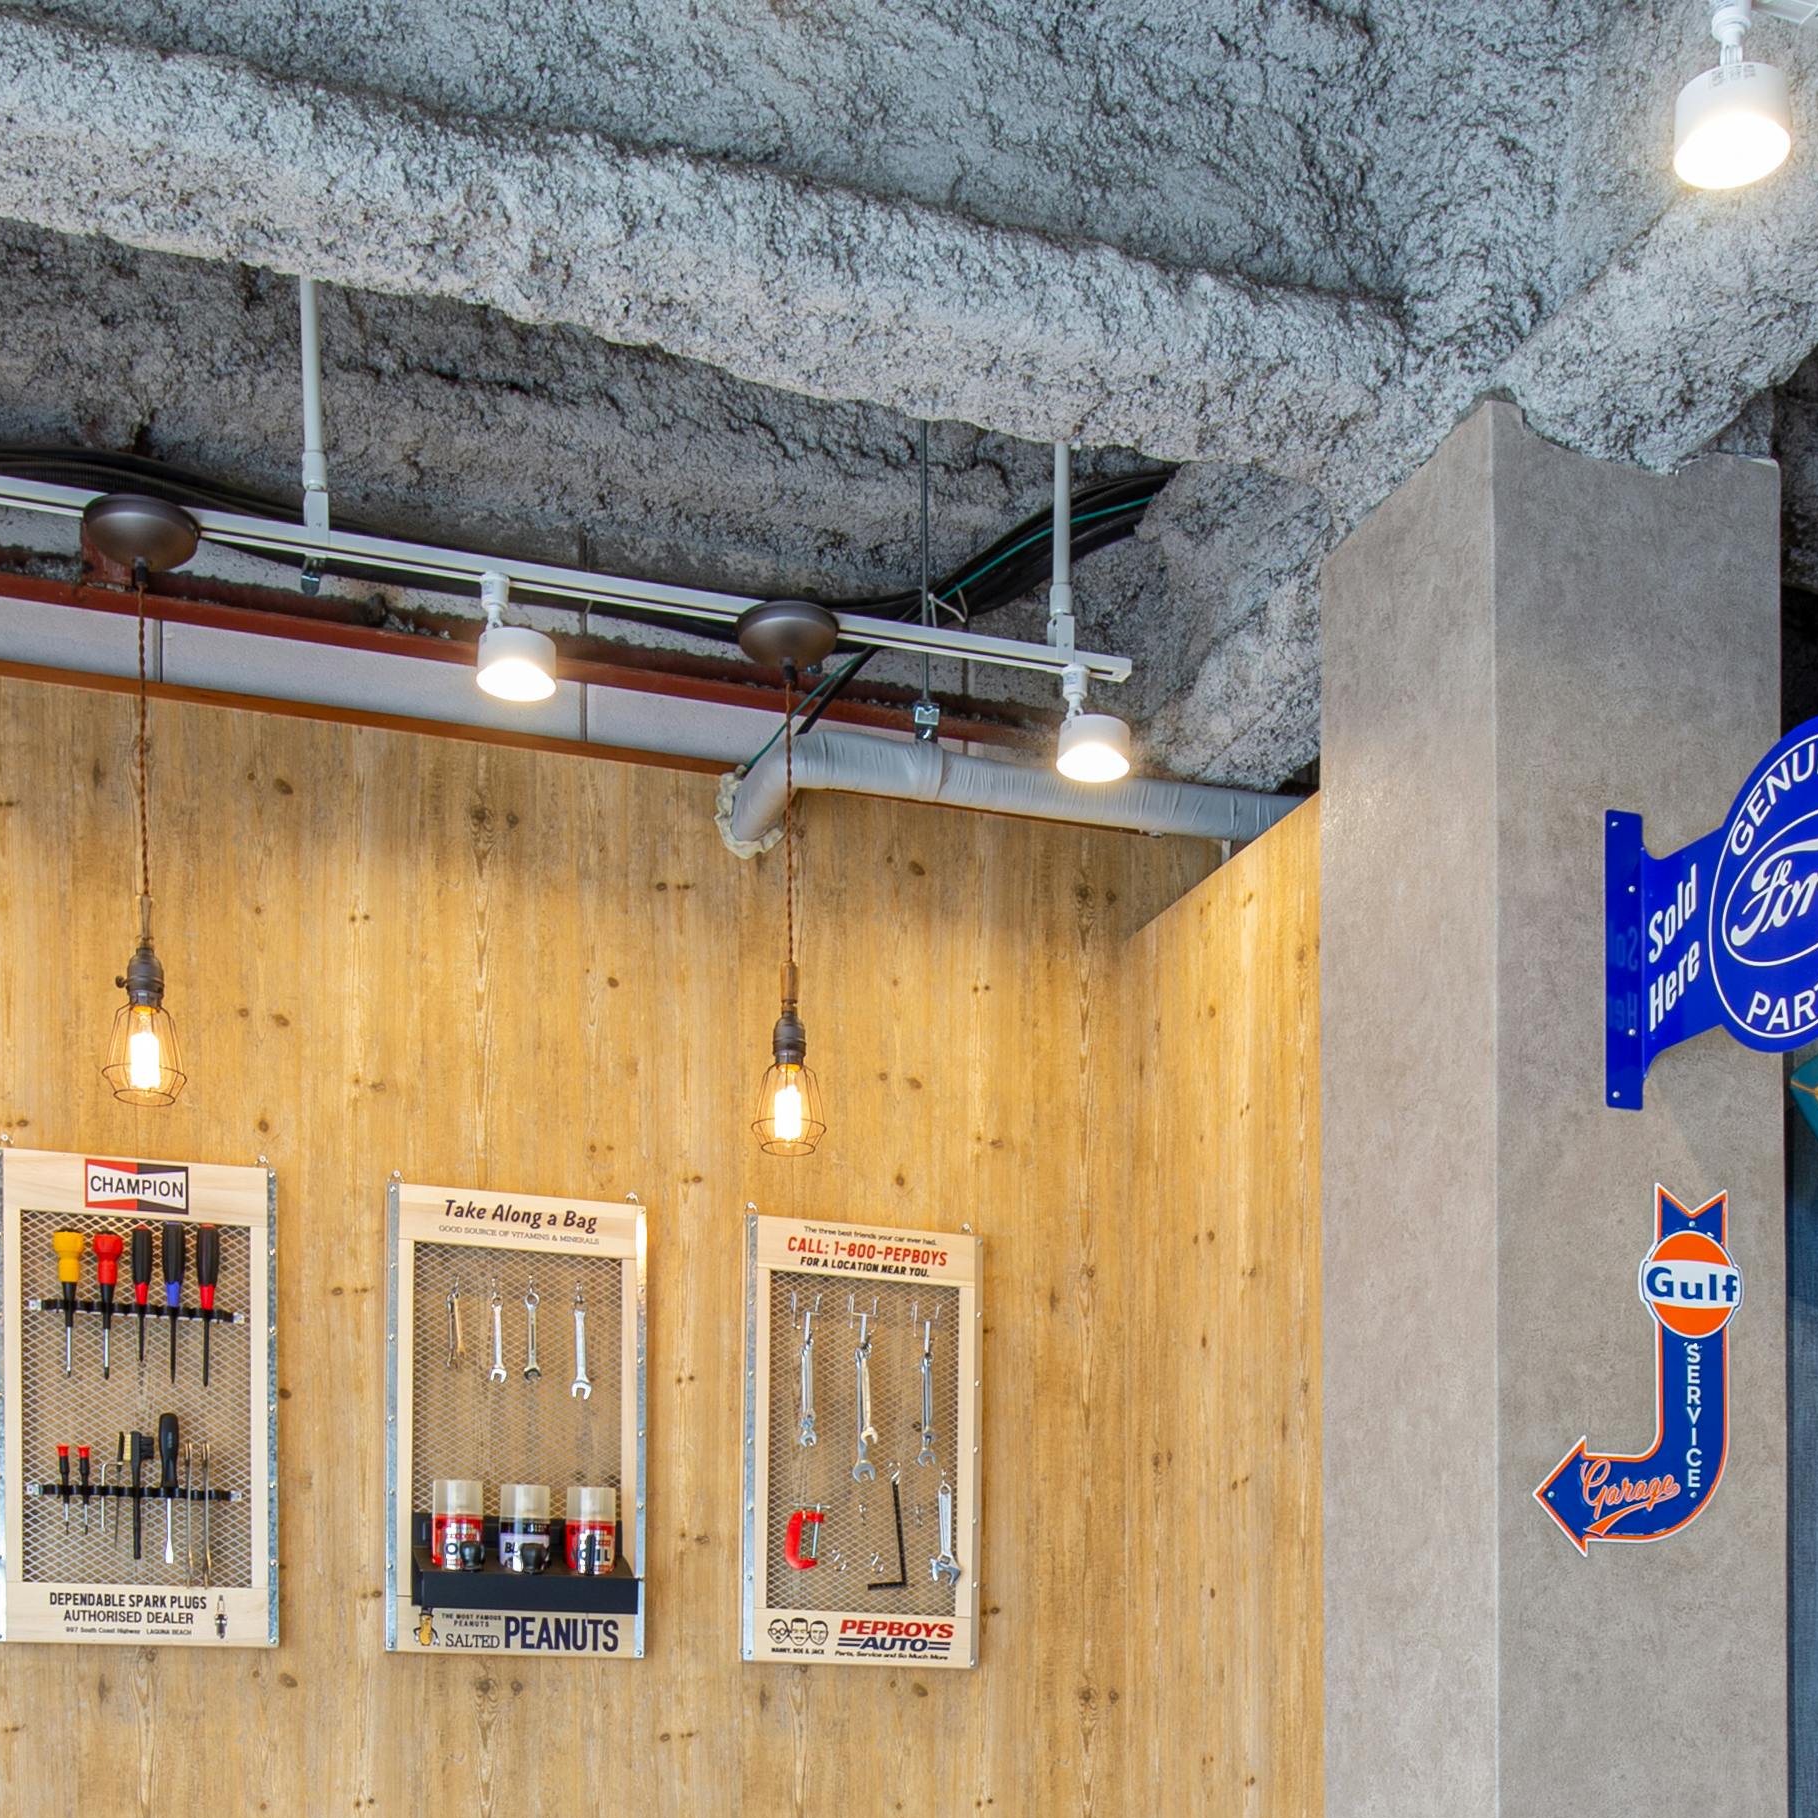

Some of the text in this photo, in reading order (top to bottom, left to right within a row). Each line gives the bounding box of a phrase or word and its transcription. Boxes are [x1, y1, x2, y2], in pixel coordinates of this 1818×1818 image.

[1648, 864, 1698, 965] Sold
[1649, 941, 1700, 1032] Here
[90, 1175, 184, 1198] CHAMPION
[445, 1199, 597, 1234] Take Along a Bag
[438, 1225, 463, 1233] GOOD
[464, 1226, 497, 1237] SOURCE
[511, 1231, 550, 1241] VITAMINS
[559, 1235, 600, 1245] MINERALS
[837, 1229, 852, 1237] best
[853, 1230, 877, 1239] friends
[878, 1234, 893, 1242] your
[922, 1238, 937, 1246] had.
[787, 1236, 948, 1267] CALL: 1-800-PEPBOYS
[800, 1256, 930, 1278] FOR A LOCATION NEAR YOU.
[1646, 1265, 1739, 1302] Gulf
[1686, 1342, 1703, 1488] SERVICE
[1580, 1458, 1681, 1520] Garage
[49, 1592, 207, 1610] DEPENDABLE SPARK PLUGS
[63, 1610, 194, 1625] AUTHORISED DEALER
[117, 1628, 141, 1636] Highway
[445, 1615, 619, 1652] SALTED PEANUTS
[840, 1619, 954, 1639] PEPBOYS
[834, 1650, 855, 1658] Parts,
[860, 1637, 928, 1651] AUTO
